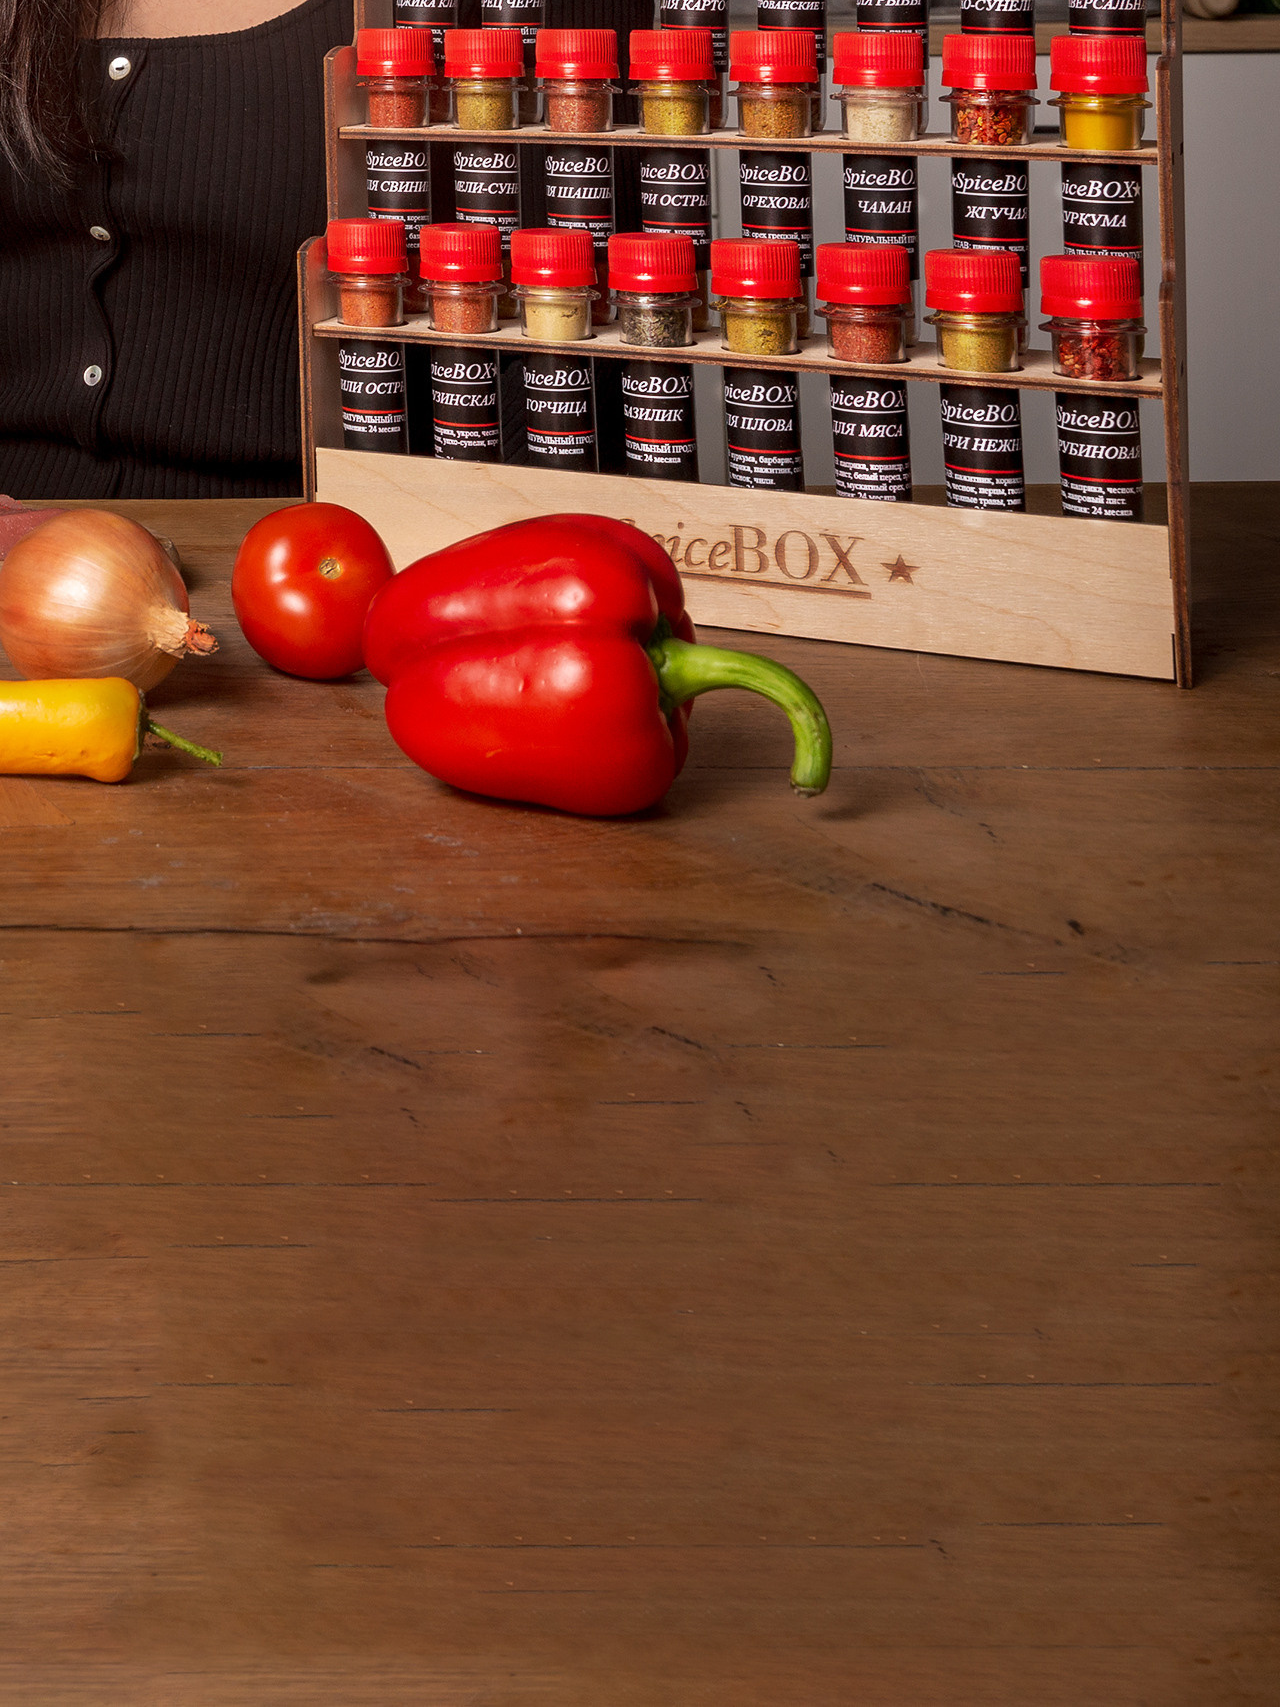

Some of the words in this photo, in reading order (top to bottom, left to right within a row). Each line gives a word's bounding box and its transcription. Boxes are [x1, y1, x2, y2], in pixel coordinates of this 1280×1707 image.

[366, 151, 428, 169] SpiceBO
[454, 151, 517, 170] SpiceBO
[546, 156, 611, 175] SpiceBO
[844, 167, 916, 187] SpiceBO
[955, 172, 1028, 193] SpiceBO
[743, 195, 810, 209] ОРЕХОВАЯ
[857, 200, 912, 214] ЧАМАН
[965, 205, 1028, 220] ЖГУЧАЯ
[1063, 211, 1127, 228] УРКУМА
[339, 349, 403, 369] SpiceBO
[724, 384, 795, 403] piceBOX
[526, 398, 587, 417] ГОРЧИЦА
[624, 404, 684, 422] БАЗИЛИК
[368, 425, 378, 433] 24
[740, 418, 793, 432] ПЛОВА
[858, 423, 903, 438] МЯСА
[548, 446, 558, 455] 24
[972, 438, 1022, 453] НЕЖН
[1058, 438, 1140, 460] РУБИНОВАЯ
[643, 453, 654, 463] 24
[1091, 505, 1103, 516] 24
[619, 518, 870, 587] iceBOX
